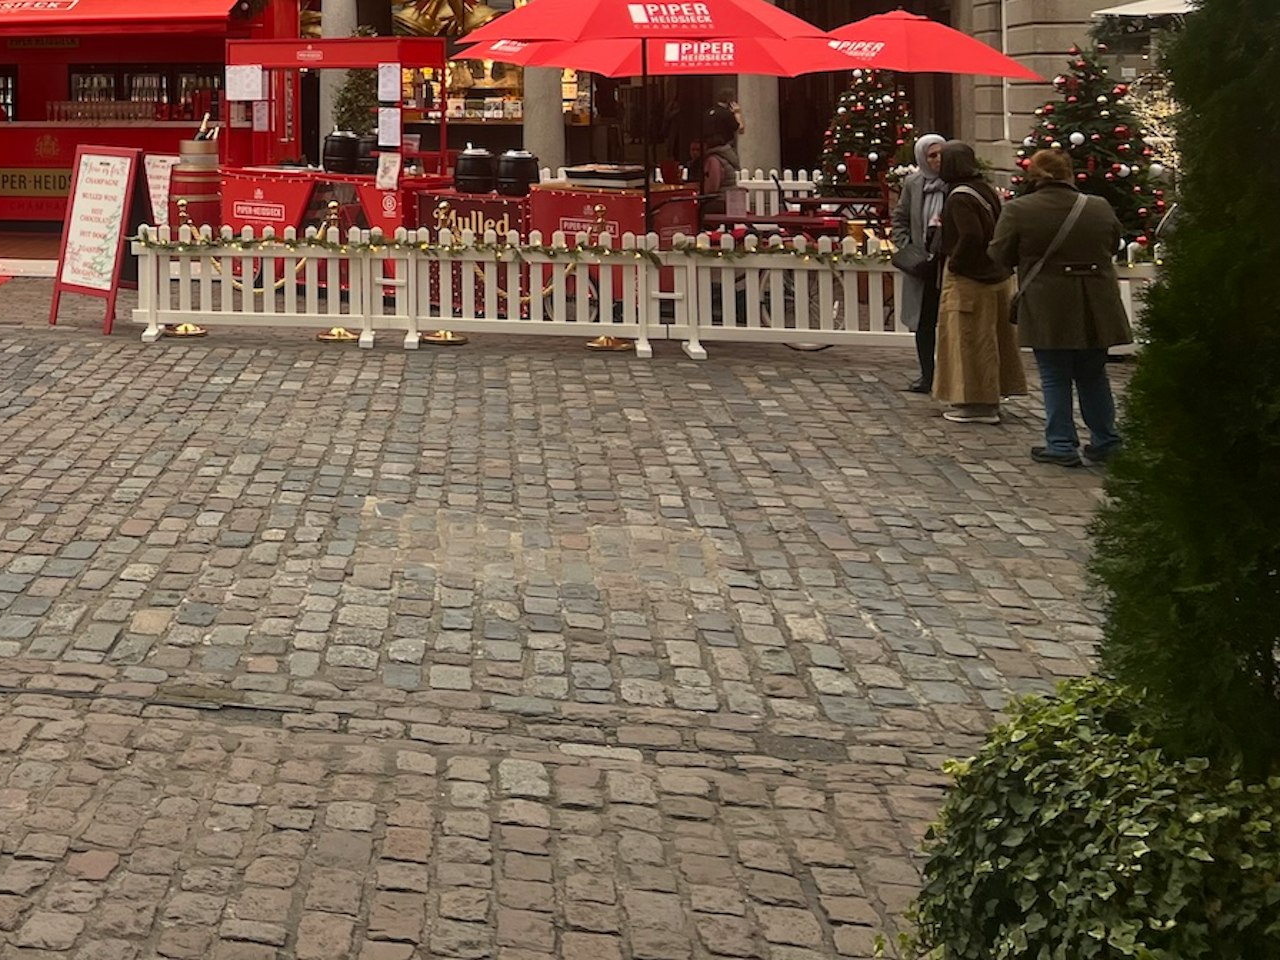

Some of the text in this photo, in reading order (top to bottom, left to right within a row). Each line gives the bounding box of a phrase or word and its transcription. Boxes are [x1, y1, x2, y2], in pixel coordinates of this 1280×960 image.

[646, 3, 709, 16] PIPER
[650, 15, 712, 23] HEIDSIECK
[680, 42, 734, 54] PIPER
[838, 41, 885, 51] PIPER
[680, 53, 734, 61] HEIDSIECK
